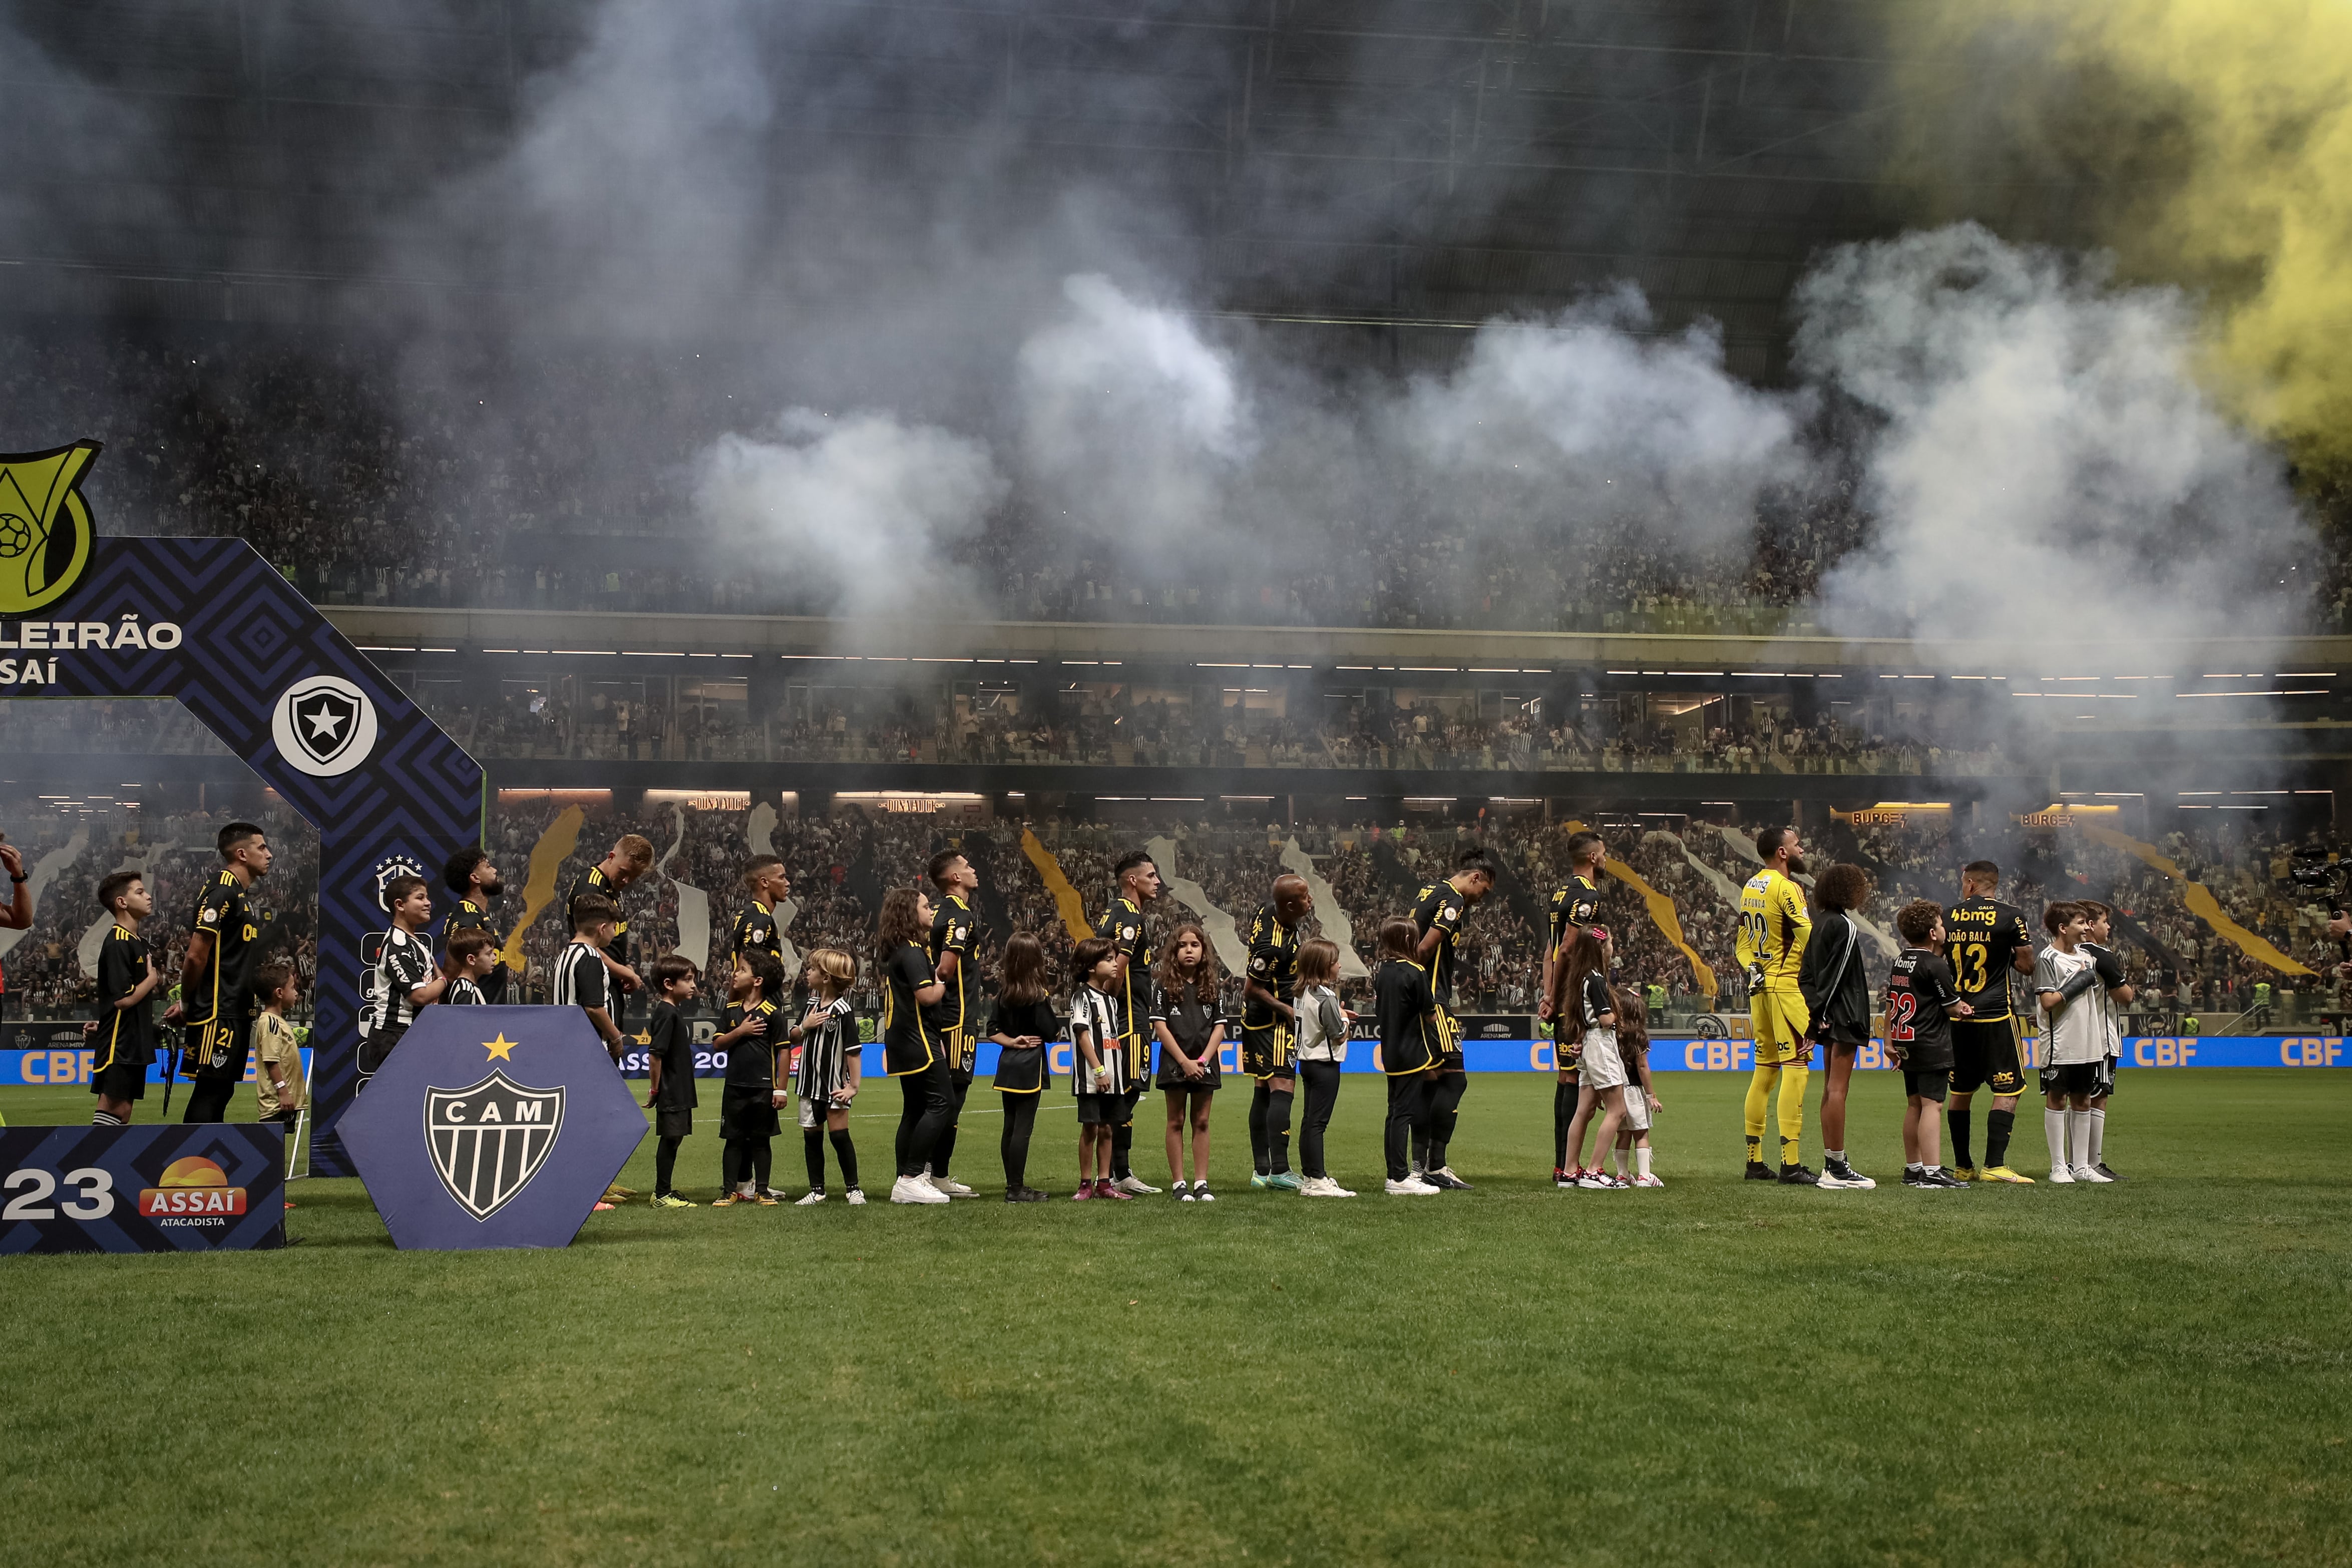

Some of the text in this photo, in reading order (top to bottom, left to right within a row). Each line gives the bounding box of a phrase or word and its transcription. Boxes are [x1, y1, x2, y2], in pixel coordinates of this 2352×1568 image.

[1786, 897, 1797, 915] MRV
[1961, 909, 1997, 926] bmg
[1947, 929, 1991, 942] JOÃO BALA
[388, 953, 411, 983] MRV
[1952, 943, 1987, 992] 13
[1936, 984, 1946, 998] MRV
[216, 1028, 234, 1048] 21
[963, 1034, 975, 1052] 10
[1143, 1045, 1149, 1062] 9
[1685, 1042, 1750, 1070] CBF
[2135, 1038, 2198, 1066] CBF
[2280, 1038, 2343, 1066] CBF
[21, 1051, 95, 1083] CBF
[1993, 1071, 2014, 1082] abc
[446, 1100, 542, 1122] CAM
[2, 1167, 115, 1220] 23
[150, 1190, 235, 1213] ASSAÍ
[160, 1218, 225, 1227] ATACADISTA
